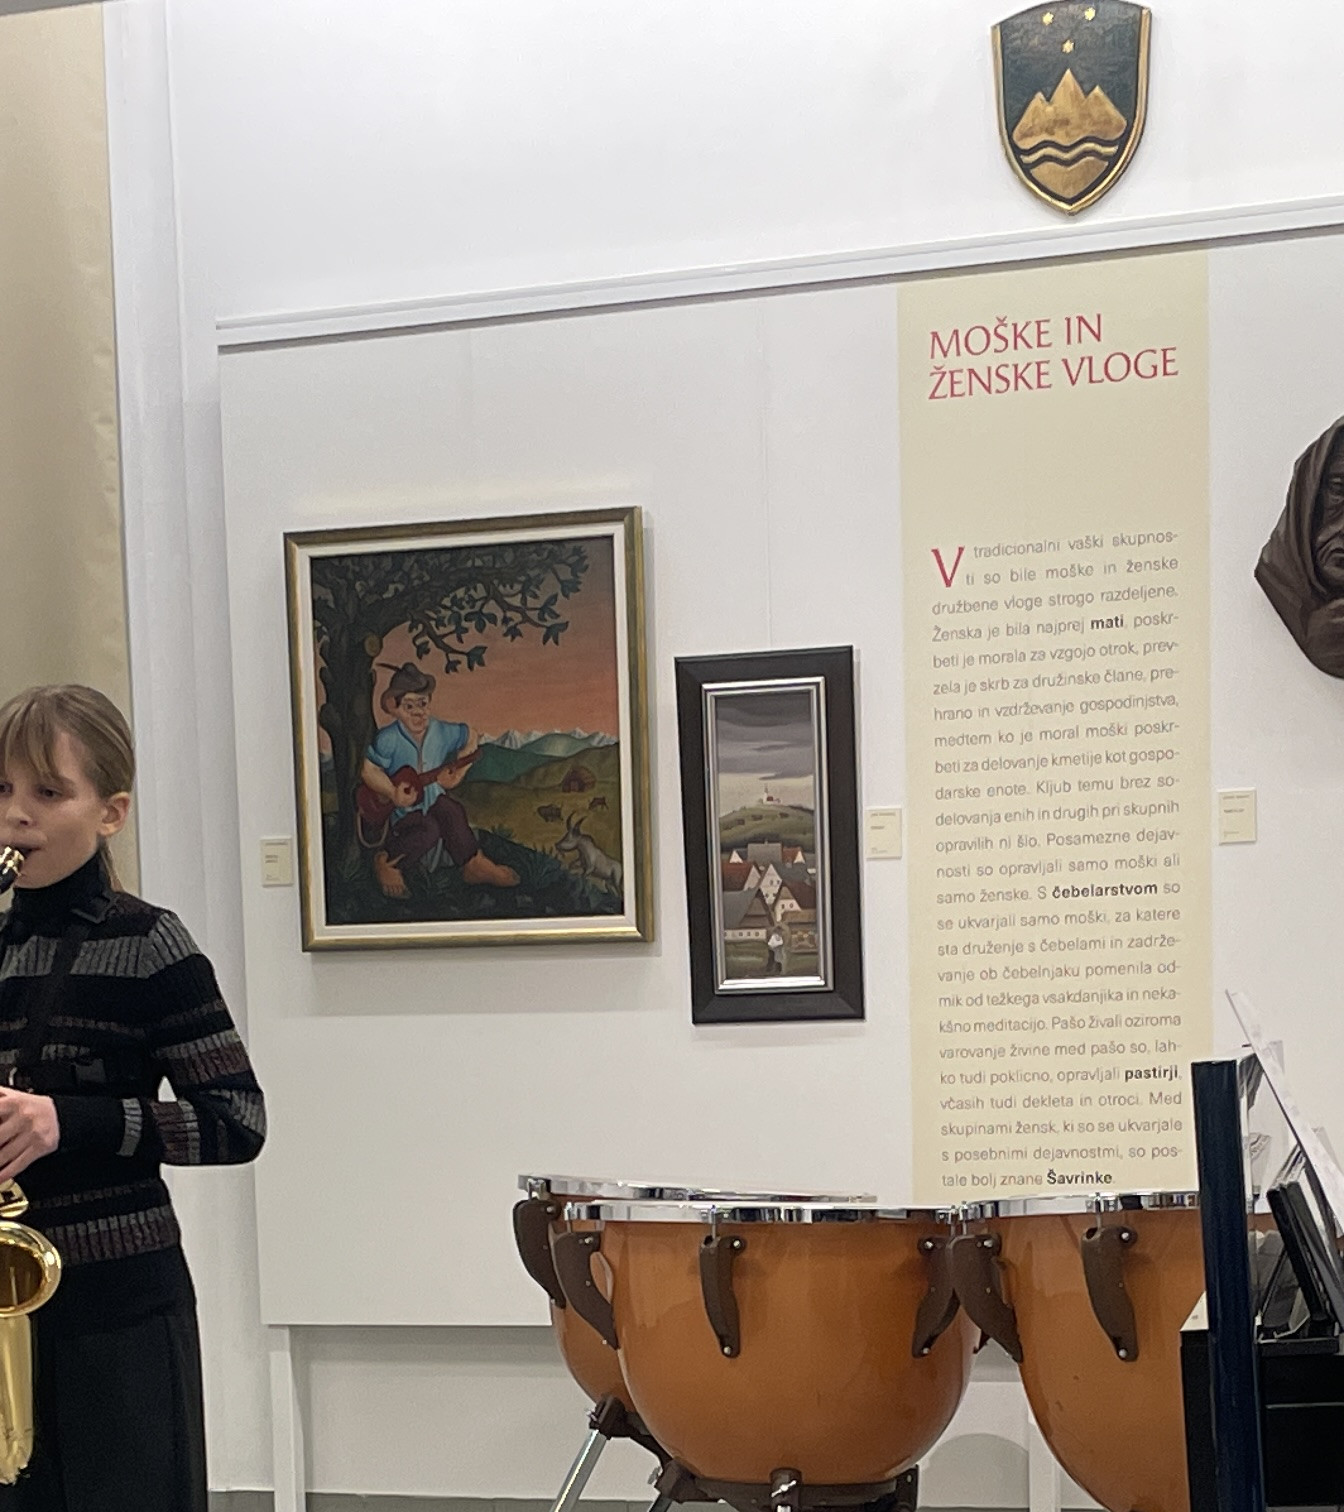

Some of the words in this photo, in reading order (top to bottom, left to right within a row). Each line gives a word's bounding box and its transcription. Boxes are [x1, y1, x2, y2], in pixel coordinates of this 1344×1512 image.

[930, 316, 1052, 359] MOŠKE
[1065, 313, 1103, 345] IN
[928, 360, 1052, 400] ŽENSKE
[1062, 347, 1179, 386] VLOGE
[931, 546, 965, 588] V
[974, 540, 1060, 558] tradicionalni
[1068, 536, 1103, 550] vaški
[966, 574, 974, 585] ti
[984, 573, 1001, 584] so
[1010, 569, 1036, 582] bile
[1104, 564, 1116, 574] in
[1126, 557, 1178, 573] ženske
[932, 600, 998, 615] družbene
[1004, 596, 1042, 611] vloge
[1049, 593, 1094, 607] strogo
[932, 625, 982, 642] Ženska
[987, 627, 1000, 641] je
[1006, 623, 1030, 636] bila
[933, 656, 958, 668] beti
[963, 655, 974, 669] je
[979, 649, 1026, 664] morala
[1030, 650, 1046, 661] za
[1050, 647, 1096, 662] vzgojo
[933, 681, 960, 695] zela
[964, 682, 976, 695] je
[980, 678, 1009, 691] skrb
[1013, 679, 1029, 689] za
[1032, 671, 1100, 688] družinske
[934, 708, 972, 720] hrano
[978, 707, 989, 718] in
[995, 702, 1074, 717] vzdrževanje
[1080, 695, 1178, 714] gospodinjstva,
[934, 734, 991, 746] medtem
[998, 731, 1014, 743] ko
[1020, 732, 1033, 745] je
[1039, 725, 1079, 740] moral
[1086, 723, 1127, 737] moški
[935, 761, 960, 773] beti
[963, 761, 978, 772] za
[981, 757, 1048, 771] delovanje
[1052, 754, 1102, 767] kmetije
[1105, 751, 1126, 763] kot
[935, 786, 981, 800] darske
[1078, 780, 1113, 791] temu
[1120, 776, 1151, 789] brez
[935, 813, 1001, 826] delovanja
[1004, 809, 1034, 822] enih
[1038, 810, 1050, 820] in
[1053, 805, 1098, 821] drugih
[1102, 806, 1120, 819] pri
[1124, 801, 1179, 817] skupnih
[936, 837, 993, 854] opravilih
[999, 837, 1011, 849] ni
[1047, 832, 1130, 846] Posamezne
[937, 865, 970, 878] nosti
[977, 866, 993, 876] so
[999, 860, 1062, 877] opravljali
[1069, 860, 1108, 872] samo
[1115, 855, 1157, 869] moški
[1164, 854, 1180, 867] ali
[937, 893, 975, 904] samo
[1038, 886, 1047, 900] S
[1052, 884, 1158, 898] čebelarstvom
[1164, 883, 1180, 894] so
[937, 919, 953, 930] se
[958, 916, 1015, 931] ukvarjali
[1020, 915, 1060, 926] samo
[1115, 912, 1131, 922] za
[1136, 909, 1180, 921] katere
[938, 945, 958, 956] sta
[962, 941, 1024, 956] druženje
[1028, 942, 1035, 953] s
[1040, 938, 1105, 952] čebelami
[1110, 938, 1123, 948] in
[938, 971, 974, 983] vanje
[980, 967, 997, 980] ob
[1003, 965, 1080, 980] čebelnjaku
[1085, 961, 1152, 979] pomenila
[939, 996, 962, 1006] mik
[966, 993, 983, 1007] od
[986, 992, 1039, 1008] težkega
[1127, 990, 1139, 1000] in
[1052, 1016, 1085, 1029] Pašo
[1088, 1015, 1122, 1028] živali
[1125, 1015, 1181, 1027] oziroma
[939, 1047, 1005, 1060] varovanje
[1010, 1044, 1050, 1057] živine
[1055, 1043, 1085, 1055] med
[1091, 1041, 1125, 1057] pašo
[940, 1073, 956, 1084] ko
[960, 1071, 985, 1084] tudi
[990, 1070, 1053, 1085] poklicno,
[1057, 1068, 1119, 1083] opravljali
[940, 1097, 984, 1110] včasih
[990, 1096, 1016, 1109] tudi
[1022, 1095, 1073, 1108] dekleta
[1080, 1096, 1092, 1106] in
[1149, 1092, 1182, 1105] Med
[1063, 1121, 1074, 1132] ki
[1078, 1122, 1095, 1133] so
[1098, 1122, 1114, 1132] se
[1118, 1118, 1182, 1134] ukvarjale
[942, 1151, 949, 1161] s
[955, 1148, 1027, 1163] posebnimi
[1033, 1147, 1123, 1162] dejavnostmi,
[1129, 1147, 1146, 1158] so
[942, 1175, 967, 1186] tale
[972, 1173, 996, 1188] bolj
[1000, 1175, 1043, 1185] znane
